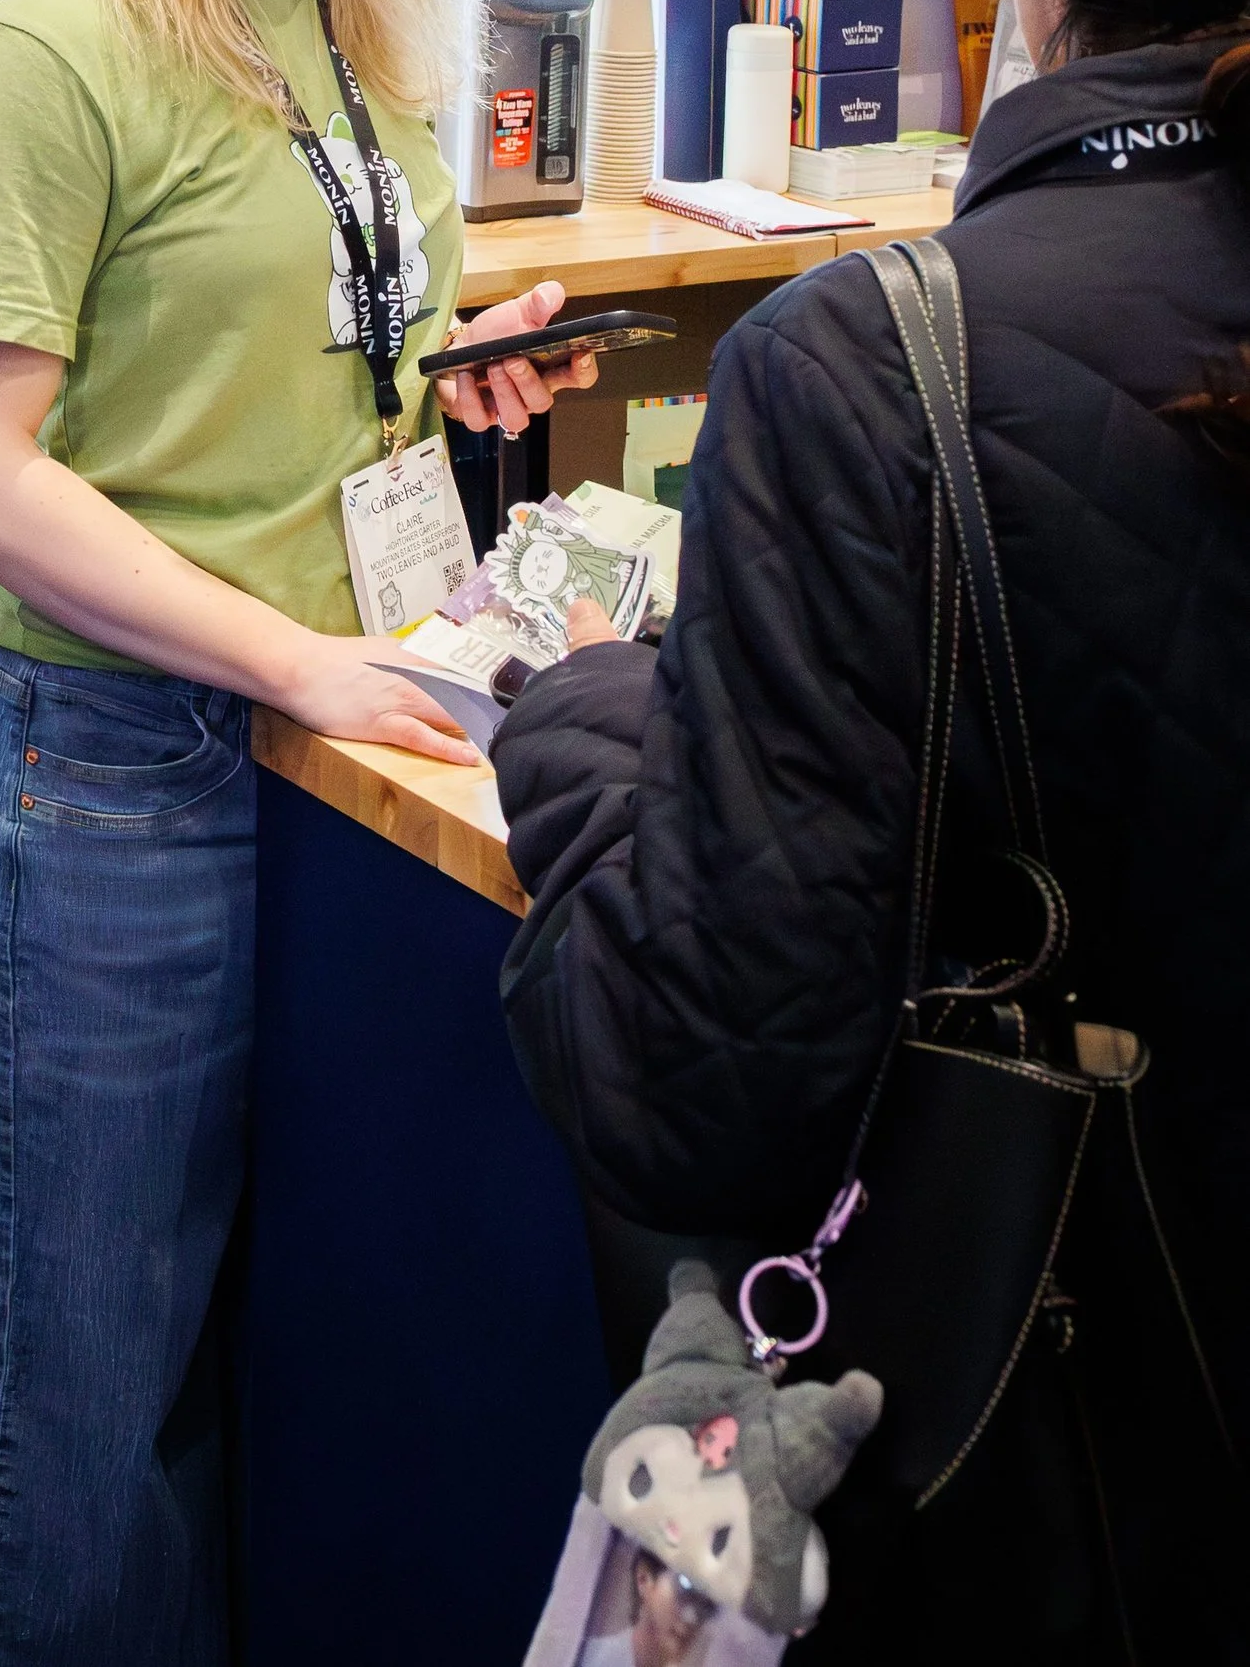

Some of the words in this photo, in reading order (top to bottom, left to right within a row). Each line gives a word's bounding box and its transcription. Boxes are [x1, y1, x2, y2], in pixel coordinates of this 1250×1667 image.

[307, 147, 351, 226] MONIN
[367, 147, 398, 226] MONIN
[355, 274, 377, 355] MONIN
[380, 276, 404, 359] MONIN
[370, 552, 400, 572] MOUNTAIN
[399, 540, 422, 557] STATES
[421, 522, 461, 547] SALESPERSON
[385, 530, 419, 552] HIGHTOWER
[418, 519, 441, 537] CARTER
[396, 512, 424, 534] CLAIRE
[640, 514, 674, 540] MATCHA
[376, 566, 394, 582] TWO
[394, 553, 422, 574] LEAVES
[423, 544, 438, 560] AND
[439, 542, 445, 553] A
[444, 534, 460, 550] BUD
